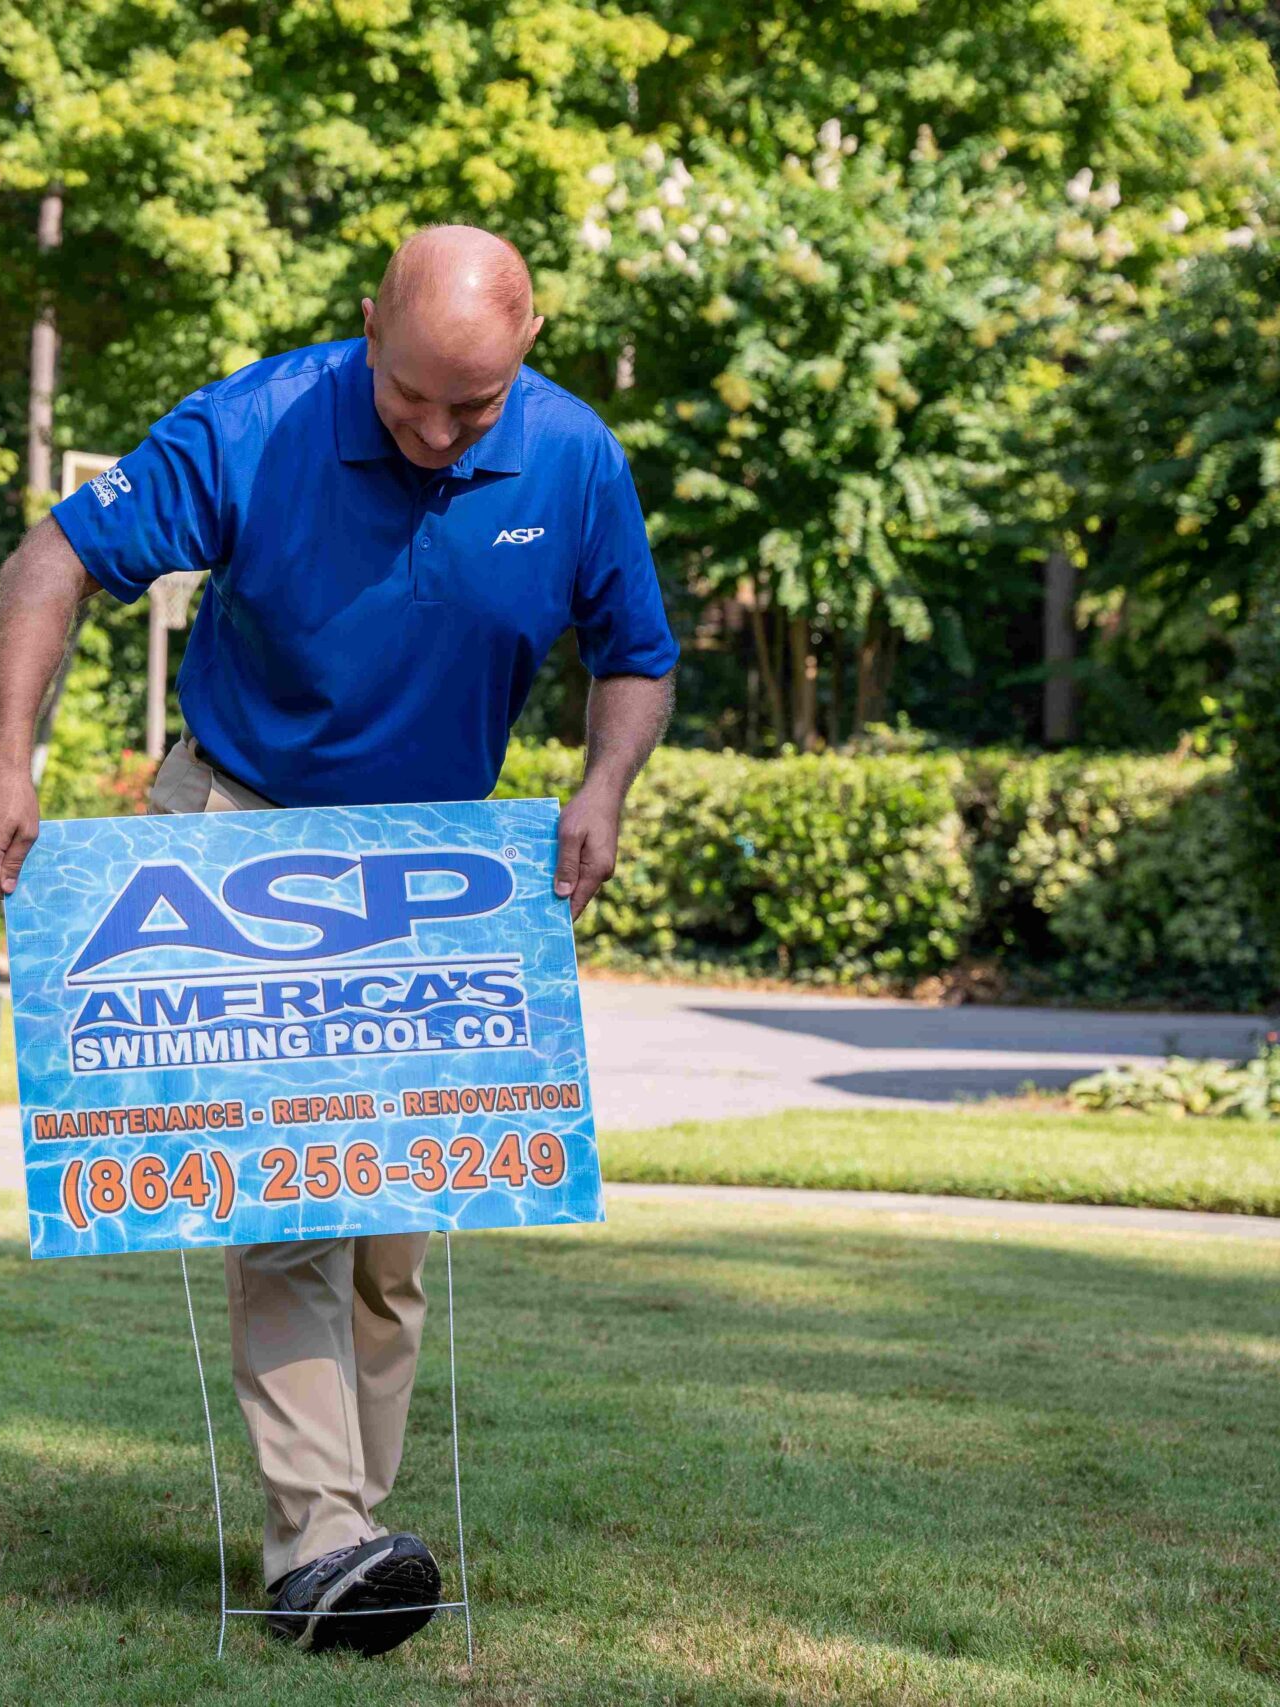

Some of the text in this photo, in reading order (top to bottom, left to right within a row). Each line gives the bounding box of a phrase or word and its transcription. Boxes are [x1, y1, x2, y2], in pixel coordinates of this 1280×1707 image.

[492, 527, 545, 547] ASP
[67, 852, 514, 977] ASP
[72, 970, 525, 1032] AMERICA'S
[74, 1013, 526, 1071] SWIMMING POOL CO.
[35, 1101, 244, 1141] MAINTENANCE
[272, 1093, 375, 1125] REPAIR
[403, 1082, 581, 1117] RENOVATION
[61, 1130, 567, 1229] (864) 256-3249
